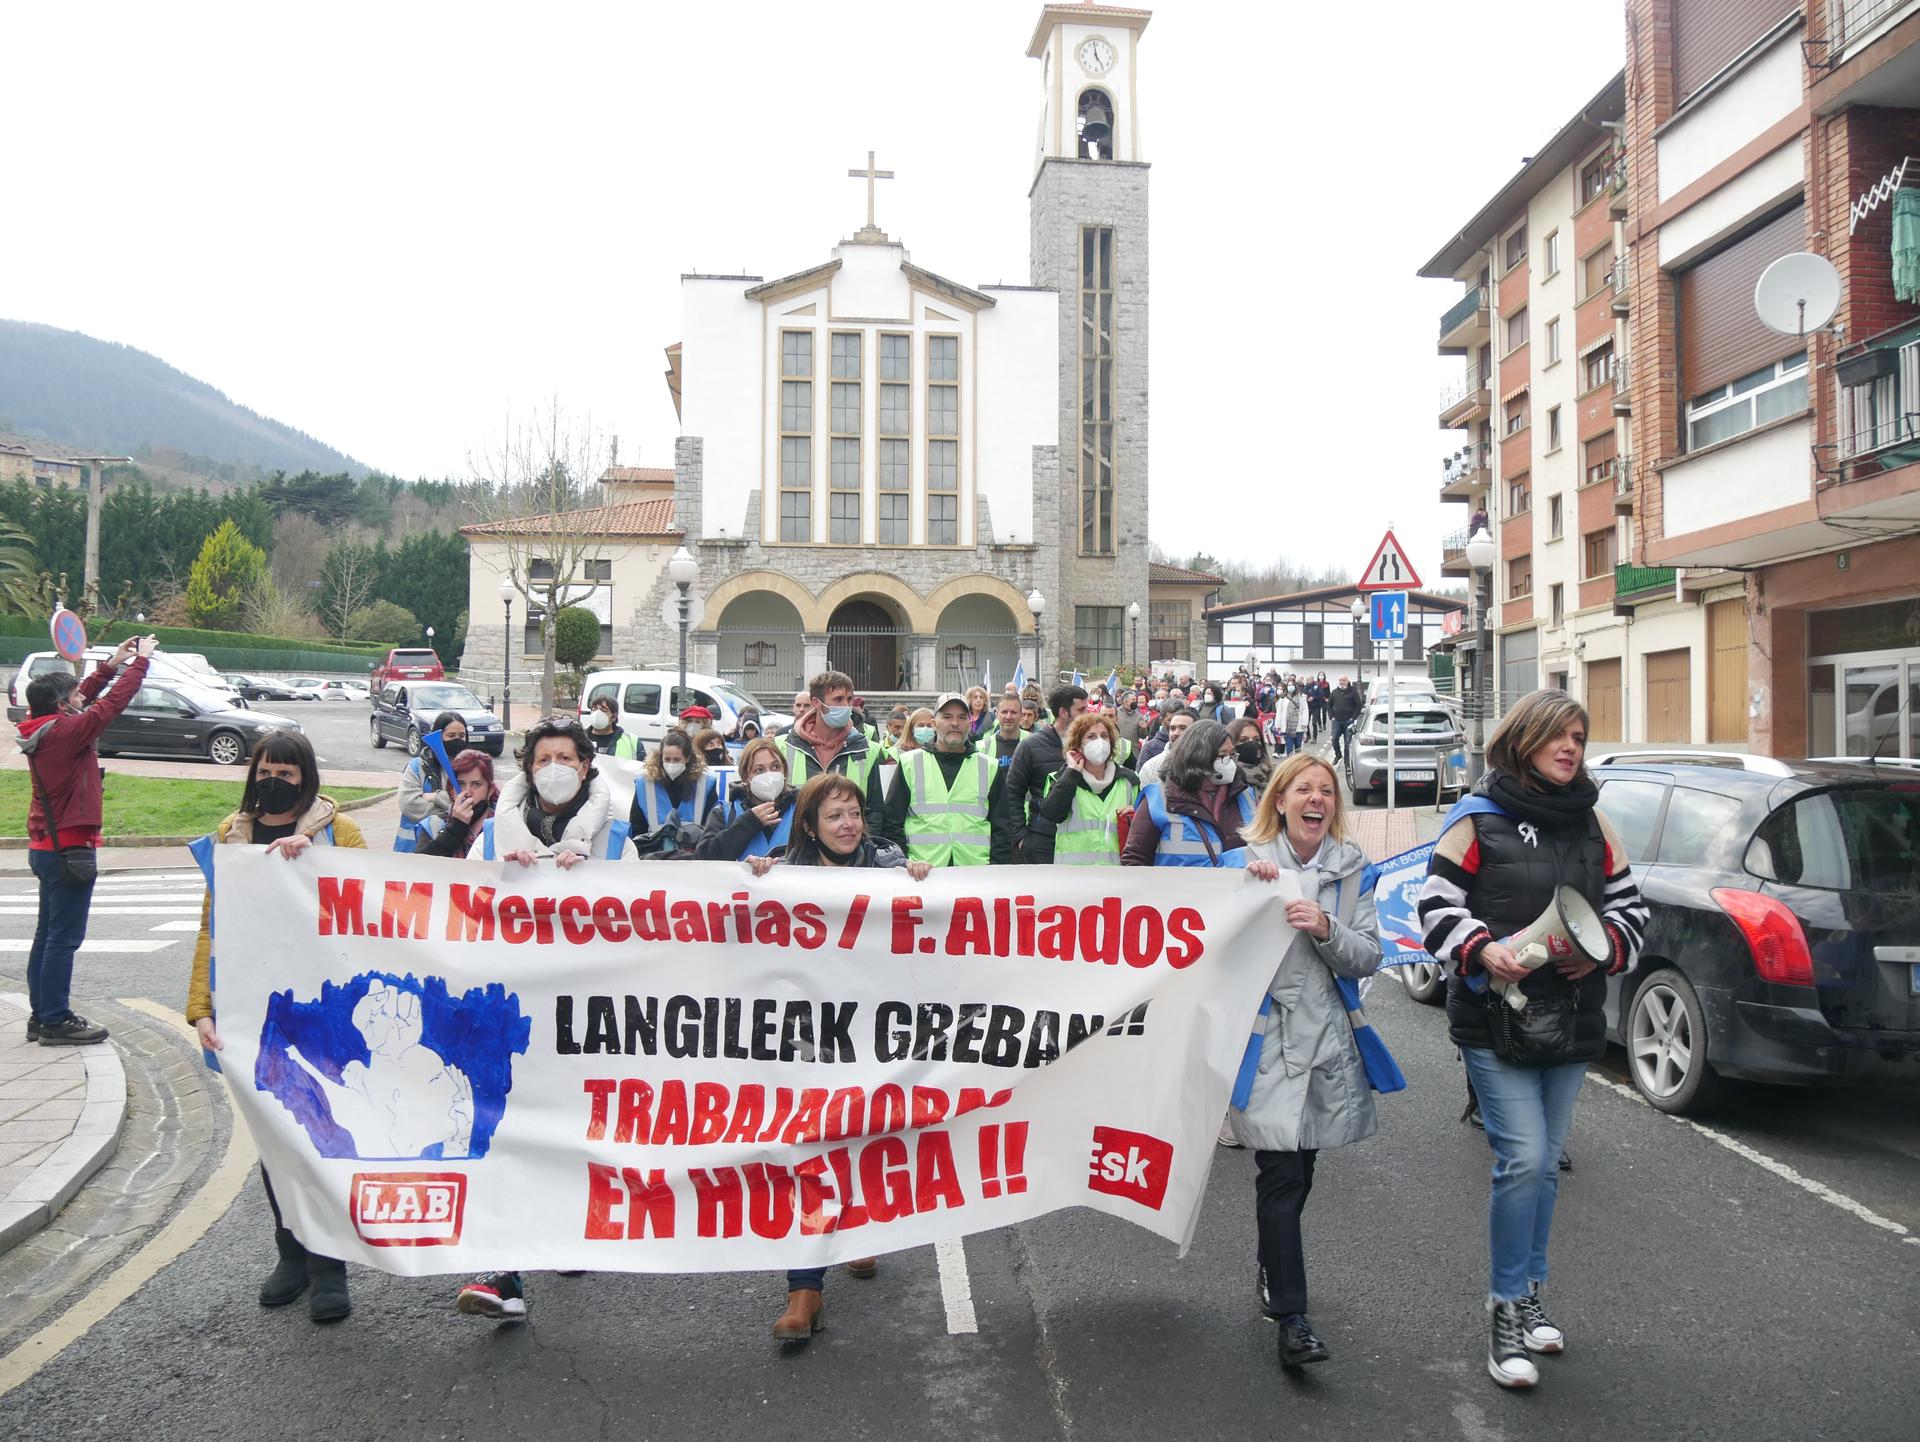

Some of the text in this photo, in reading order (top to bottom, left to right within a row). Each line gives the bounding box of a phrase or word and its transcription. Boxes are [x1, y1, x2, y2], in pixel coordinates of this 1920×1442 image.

[317, 876, 433, 941] M.M
[445, 882, 828, 951] Mercedarias
[555, 994, 859, 1064] LANGILEAK
[583, 1077, 1014, 1146] TRABAJADOR
[362, 1181, 452, 1223] LAB
[584, 1161, 676, 1240] EN
[687, 1130, 966, 1240] HUELGA
